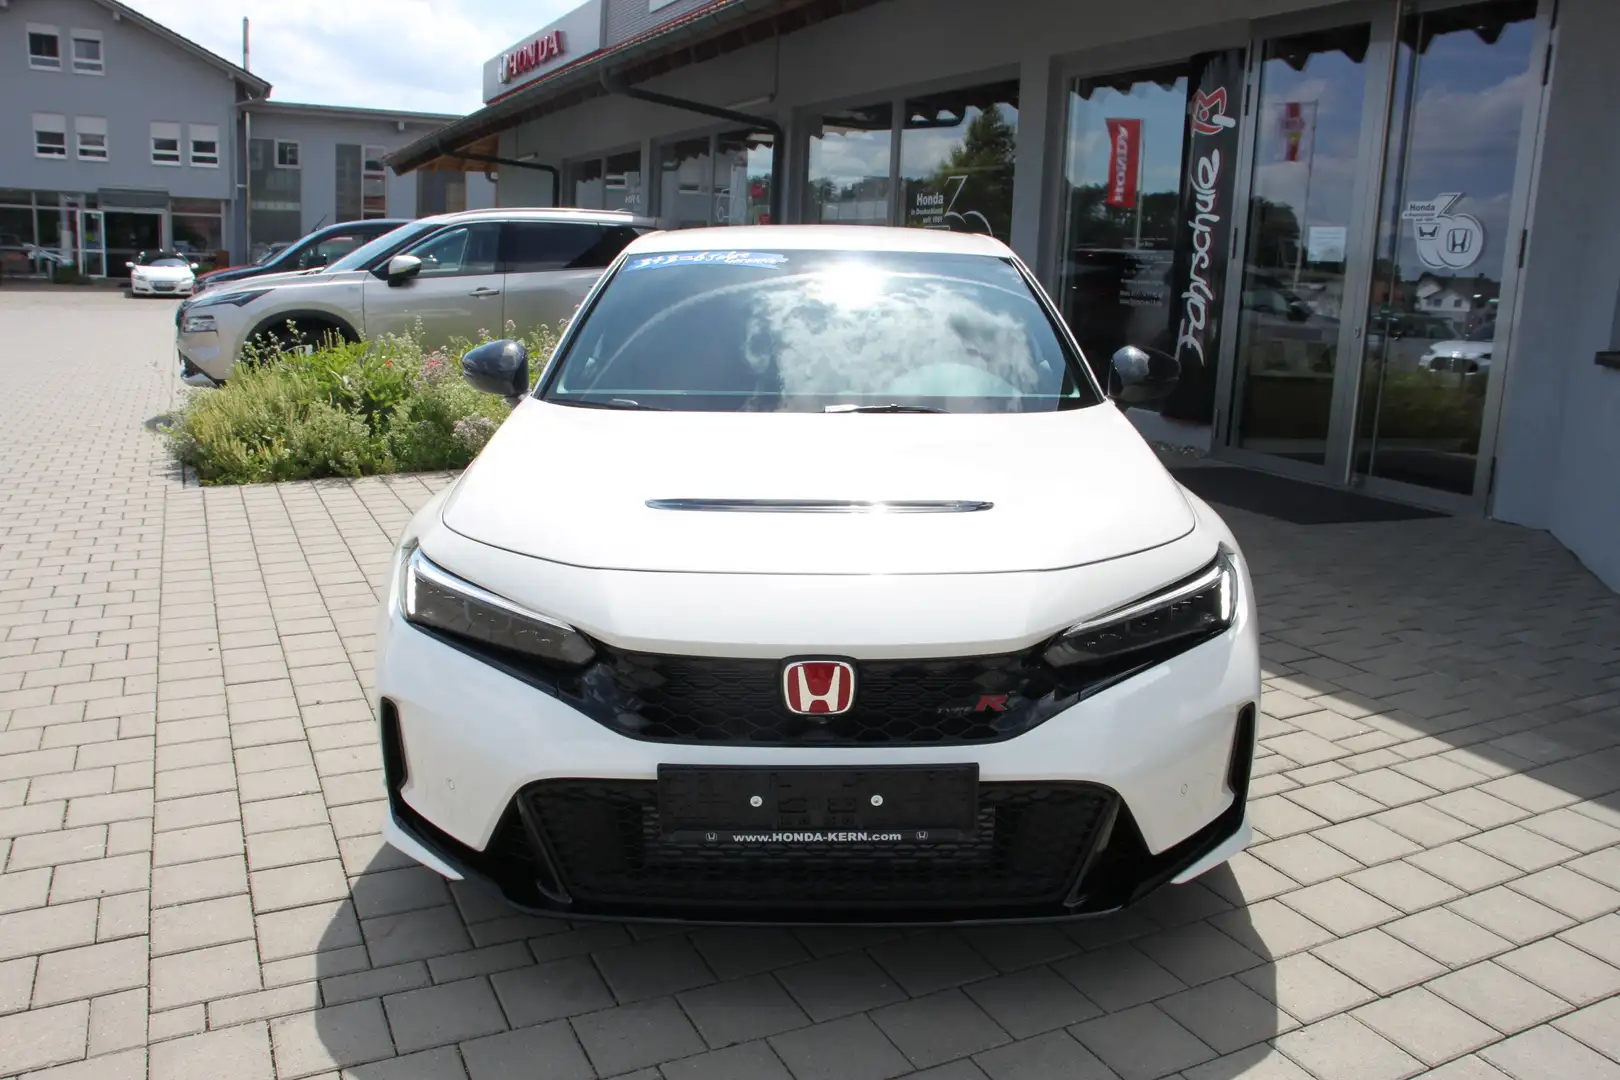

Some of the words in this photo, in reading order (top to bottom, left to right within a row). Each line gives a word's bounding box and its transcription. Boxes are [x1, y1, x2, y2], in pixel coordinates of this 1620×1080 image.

[508, 30, 564, 75] HONDA
[916, 192, 944, 206] Honda
[1409, 203, 1436, 212] Honda
[1175, 149, 1221, 366] Fahrschule
[976, 694, 1007, 712] R
[732, 832, 902, 842] www.HONDA-KERN.com
